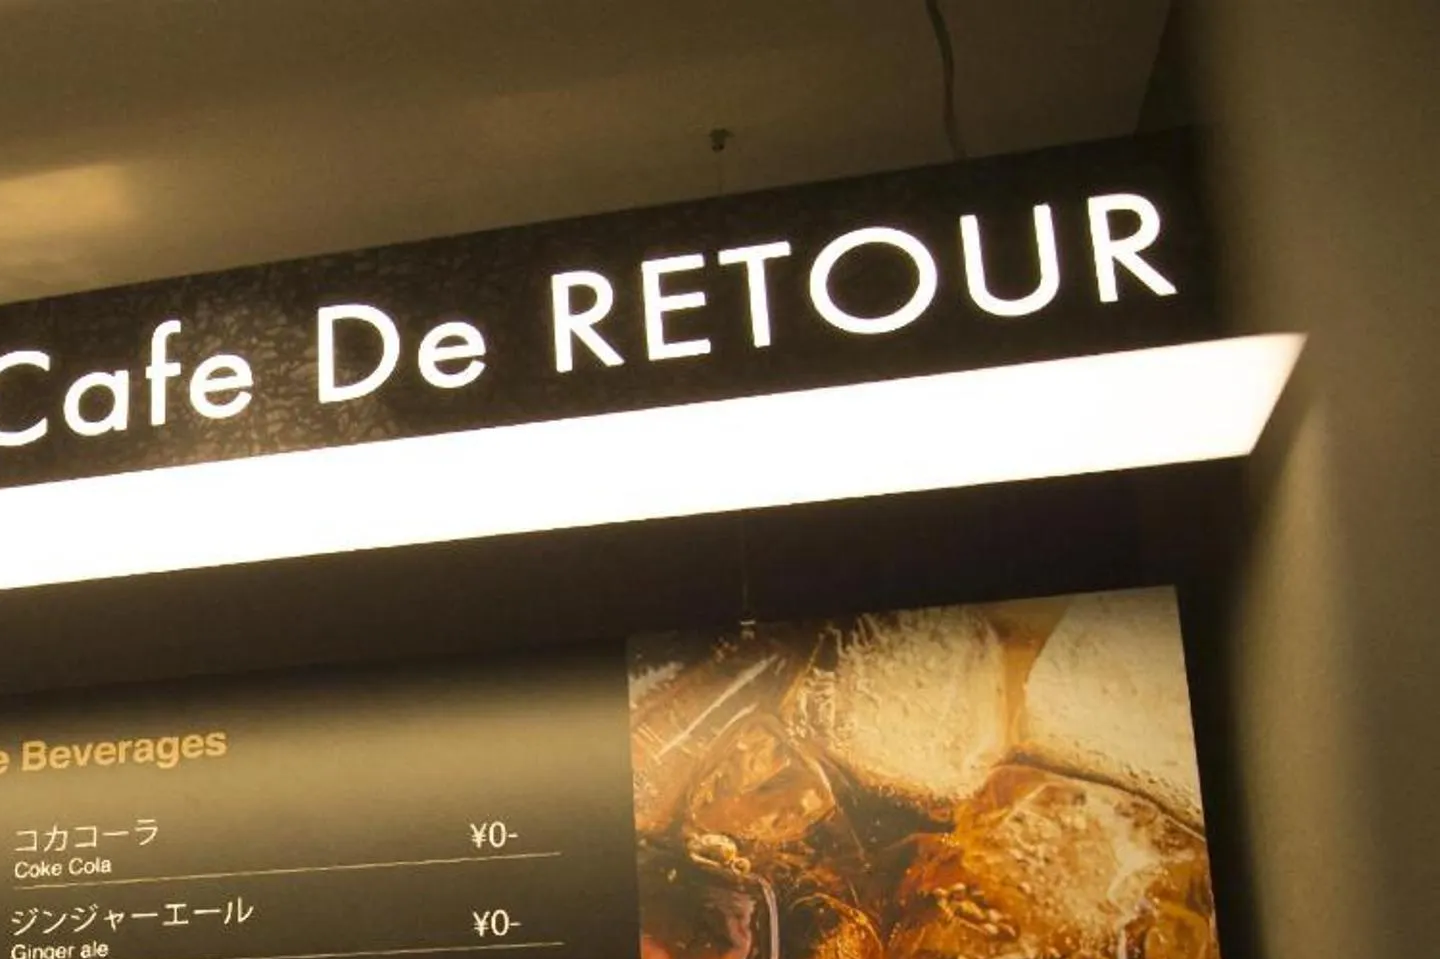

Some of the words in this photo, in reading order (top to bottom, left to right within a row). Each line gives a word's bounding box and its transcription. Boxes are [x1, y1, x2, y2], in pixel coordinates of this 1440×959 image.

[317, 303, 487, 405] De
[550, 192, 1177, 374] RETOUR
[22, 730, 228, 771] Beverages
[14, 818, 158, 853] コカコーラ
[14, 860, 63, 879] Coke
[68, 856, 112, 876] Cola
[11, 897, 254, 936] ジンジャーエール
[80, 940, 109, 959] ale
